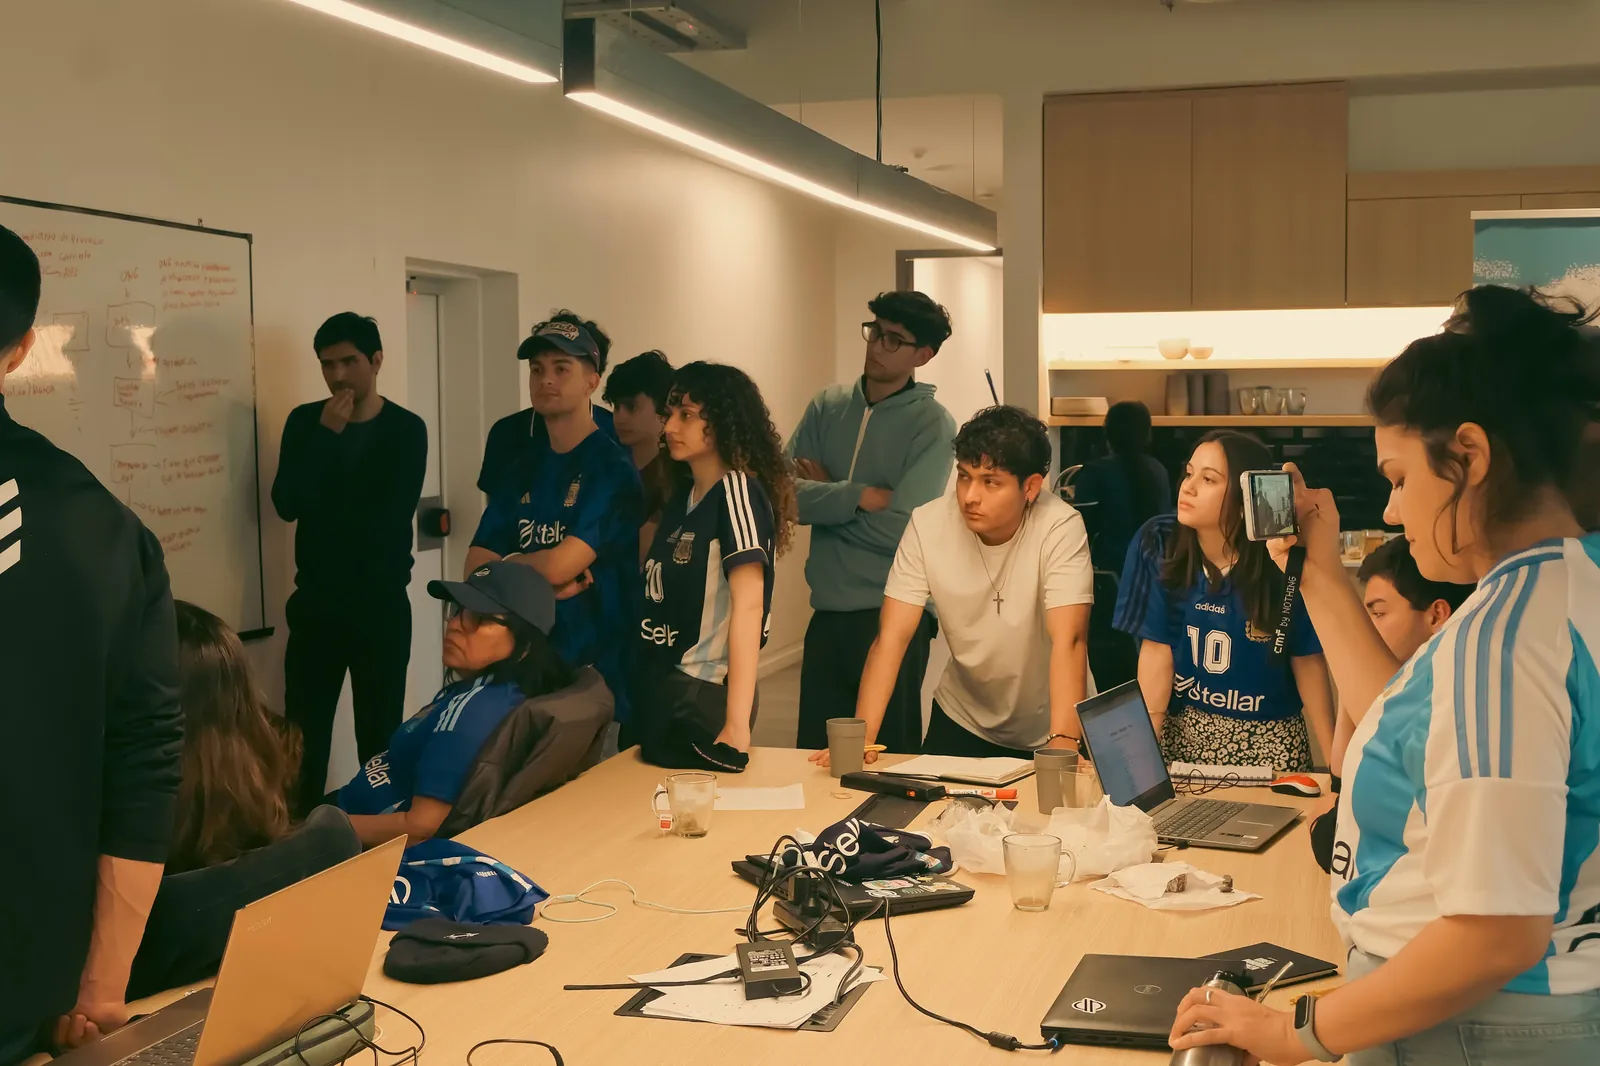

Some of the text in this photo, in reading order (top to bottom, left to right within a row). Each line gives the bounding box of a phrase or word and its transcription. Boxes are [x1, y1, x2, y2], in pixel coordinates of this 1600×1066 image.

[1282, 575, 1297, 614] NOTHING
[1194, 602, 1226, 614] adidas
[1280, 616, 1291, 627] by
[1186, 624, 1232, 674] 10
